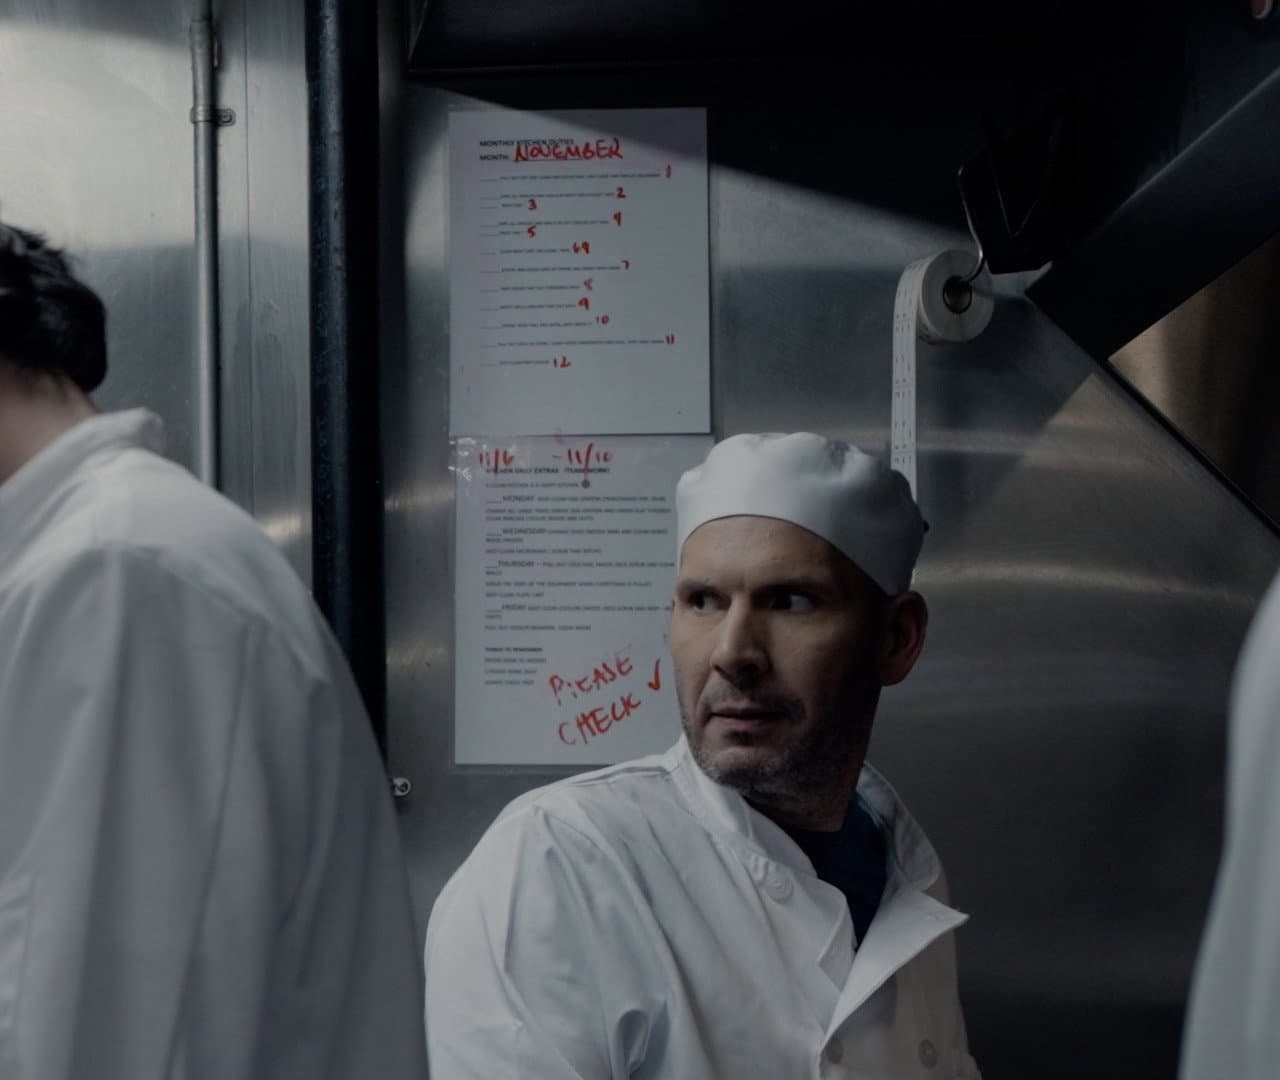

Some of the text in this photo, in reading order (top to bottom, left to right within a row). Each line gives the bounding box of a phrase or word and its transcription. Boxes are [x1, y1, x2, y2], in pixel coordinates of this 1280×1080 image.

[514, 137, 623, 162] NOVEMBER
[615, 186, 627, 199] 2
[527, 199, 537, 210] 3
[526, 224, 537, 238] 5
[578, 297, 589, 310] 9
[596, 314, 610, 325] 10
[552, 355, 572, 369] 12
[558, 692, 641, 746] CHECK
